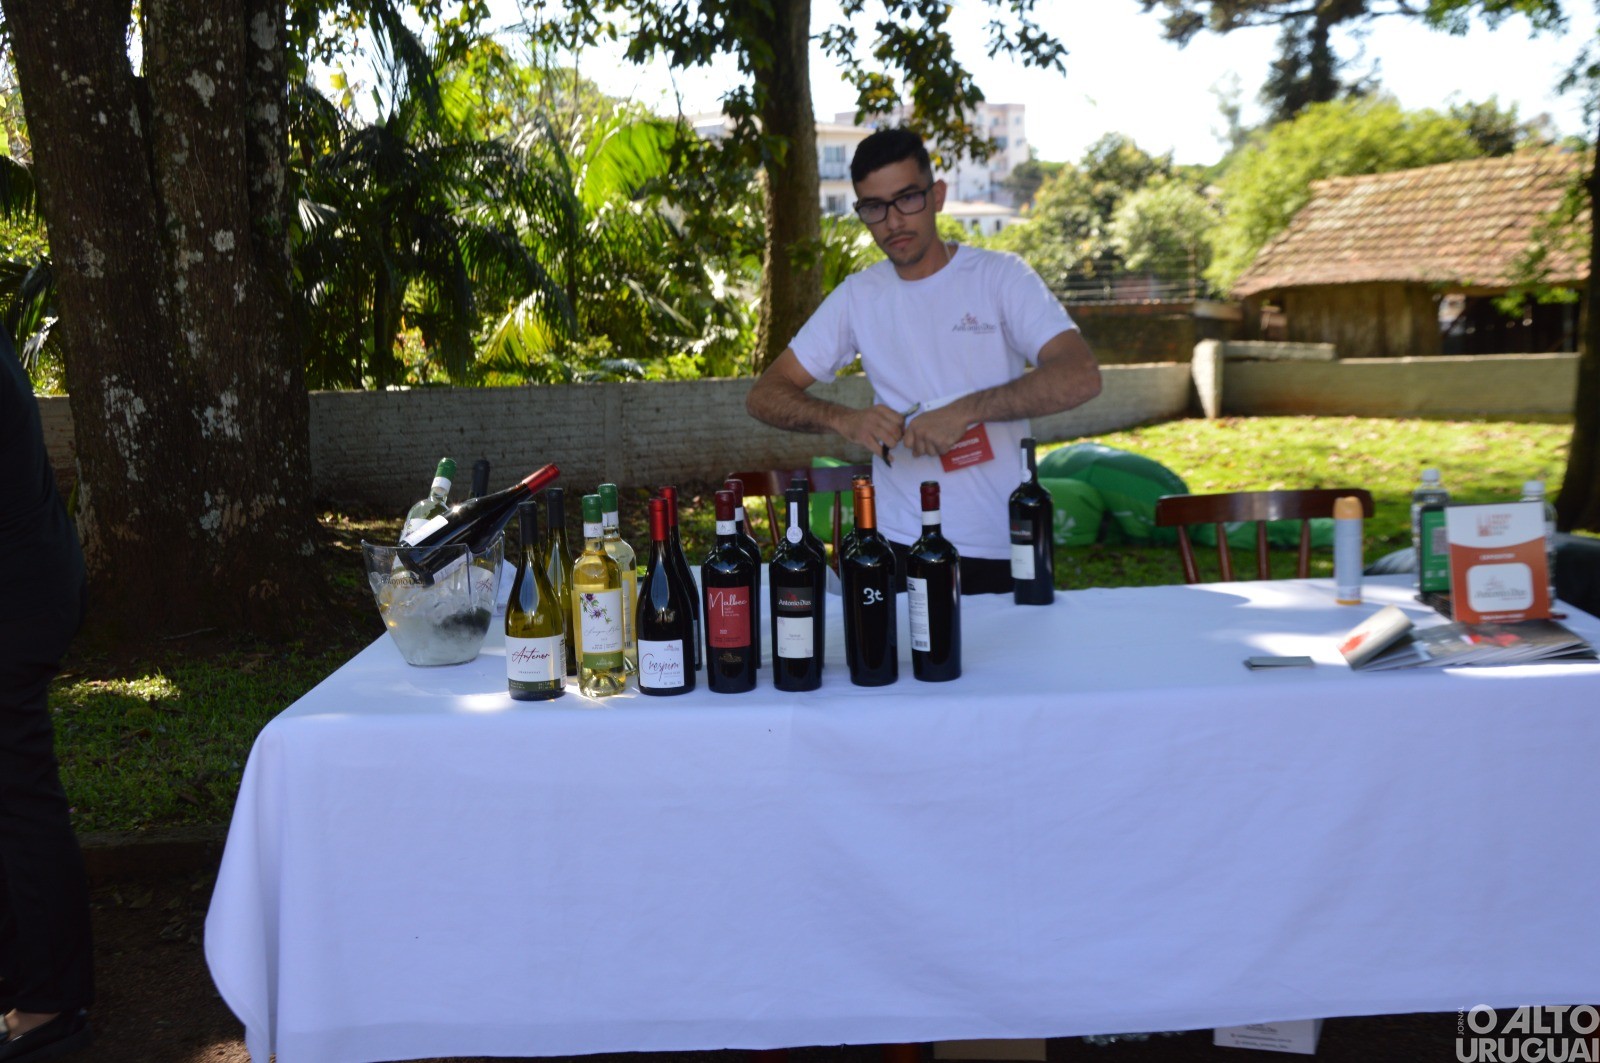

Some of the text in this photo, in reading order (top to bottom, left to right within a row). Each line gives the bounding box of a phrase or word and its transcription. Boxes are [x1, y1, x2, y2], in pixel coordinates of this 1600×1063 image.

[708, 591, 747, 617] Malbec
[862, 587, 884, 605] 3t
[512, 646, 550, 664] Antenor
